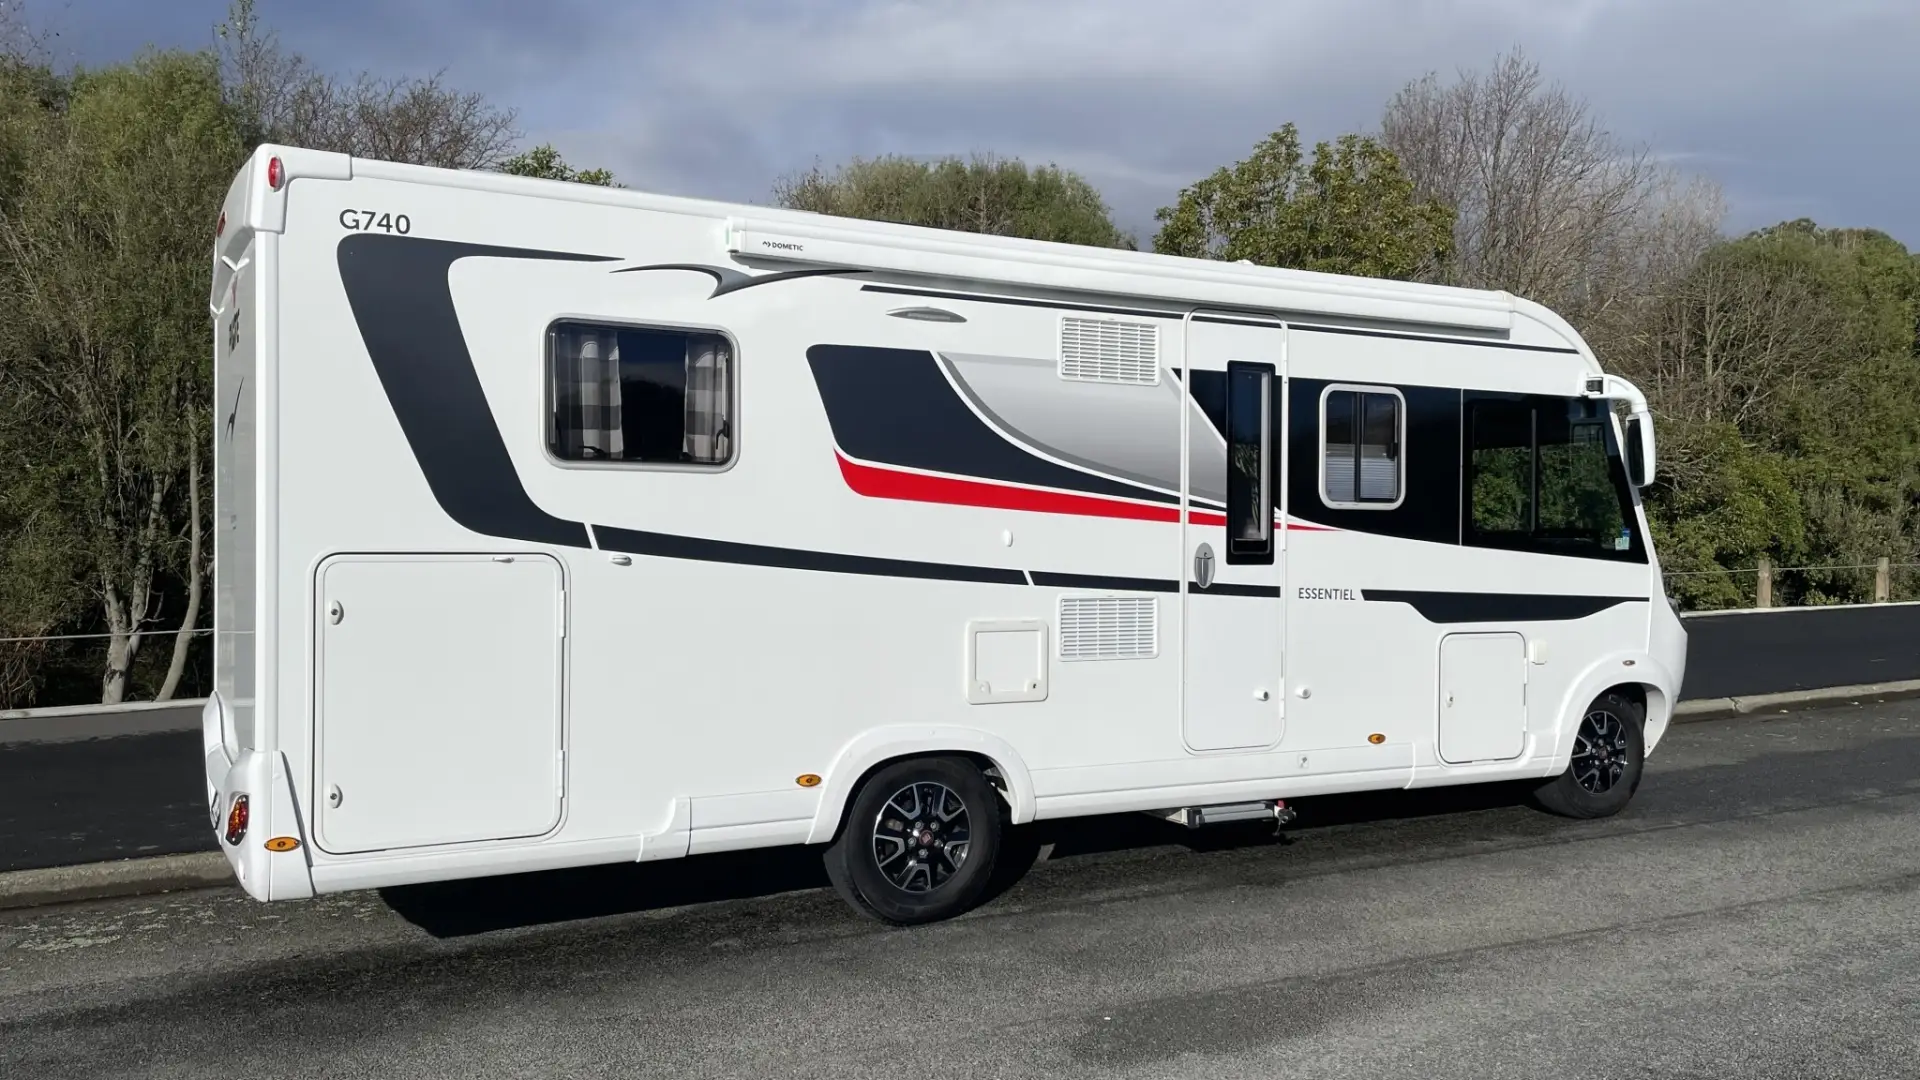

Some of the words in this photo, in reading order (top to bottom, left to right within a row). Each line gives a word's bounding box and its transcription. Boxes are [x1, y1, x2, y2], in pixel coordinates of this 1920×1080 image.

[339, 208, 411, 235] G740
[772, 241, 804, 252] DOMETIC
[1298, 587, 1356, 601] ESSENTIEL
